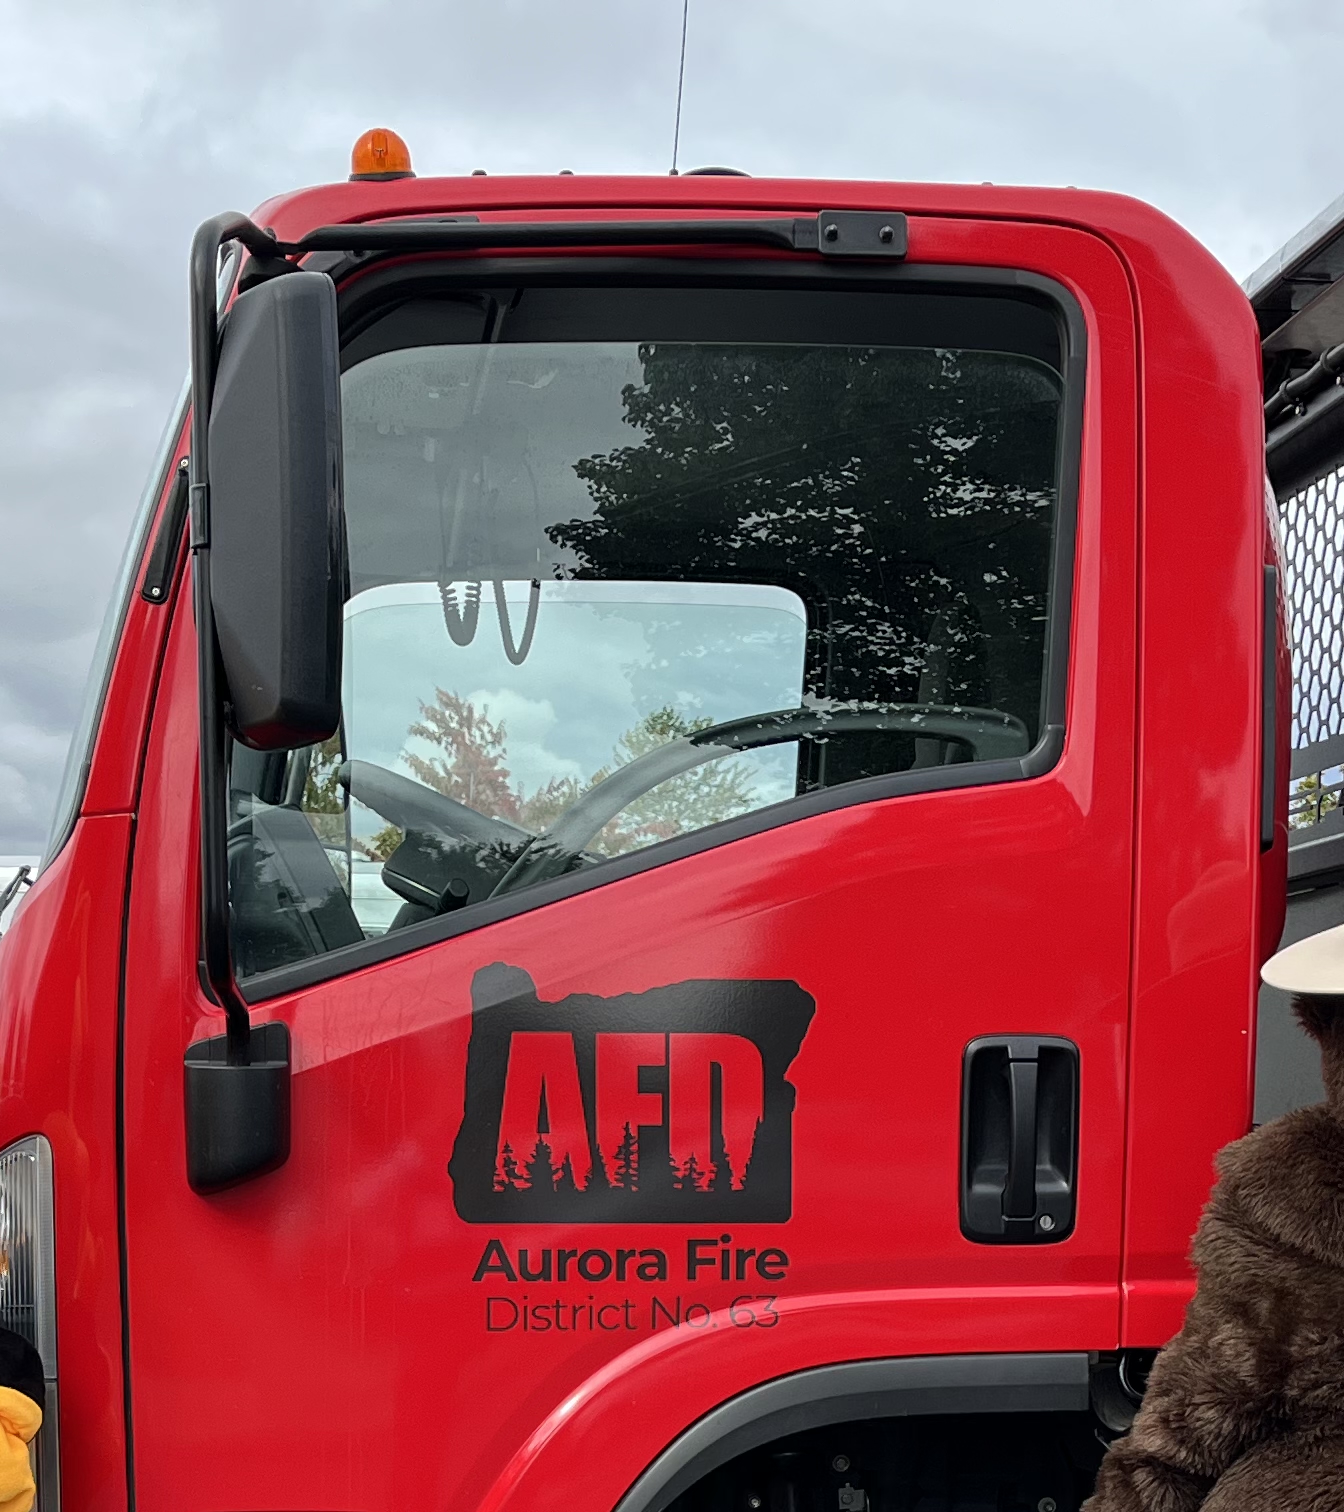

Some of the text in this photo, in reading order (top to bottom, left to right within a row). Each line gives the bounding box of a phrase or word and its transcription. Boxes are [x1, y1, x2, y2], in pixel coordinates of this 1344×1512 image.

[492, 1031, 765, 1193] AFD
[472, 1234, 789, 1281] Aurora Fire
[486, 1296, 780, 1331] District No. 63
